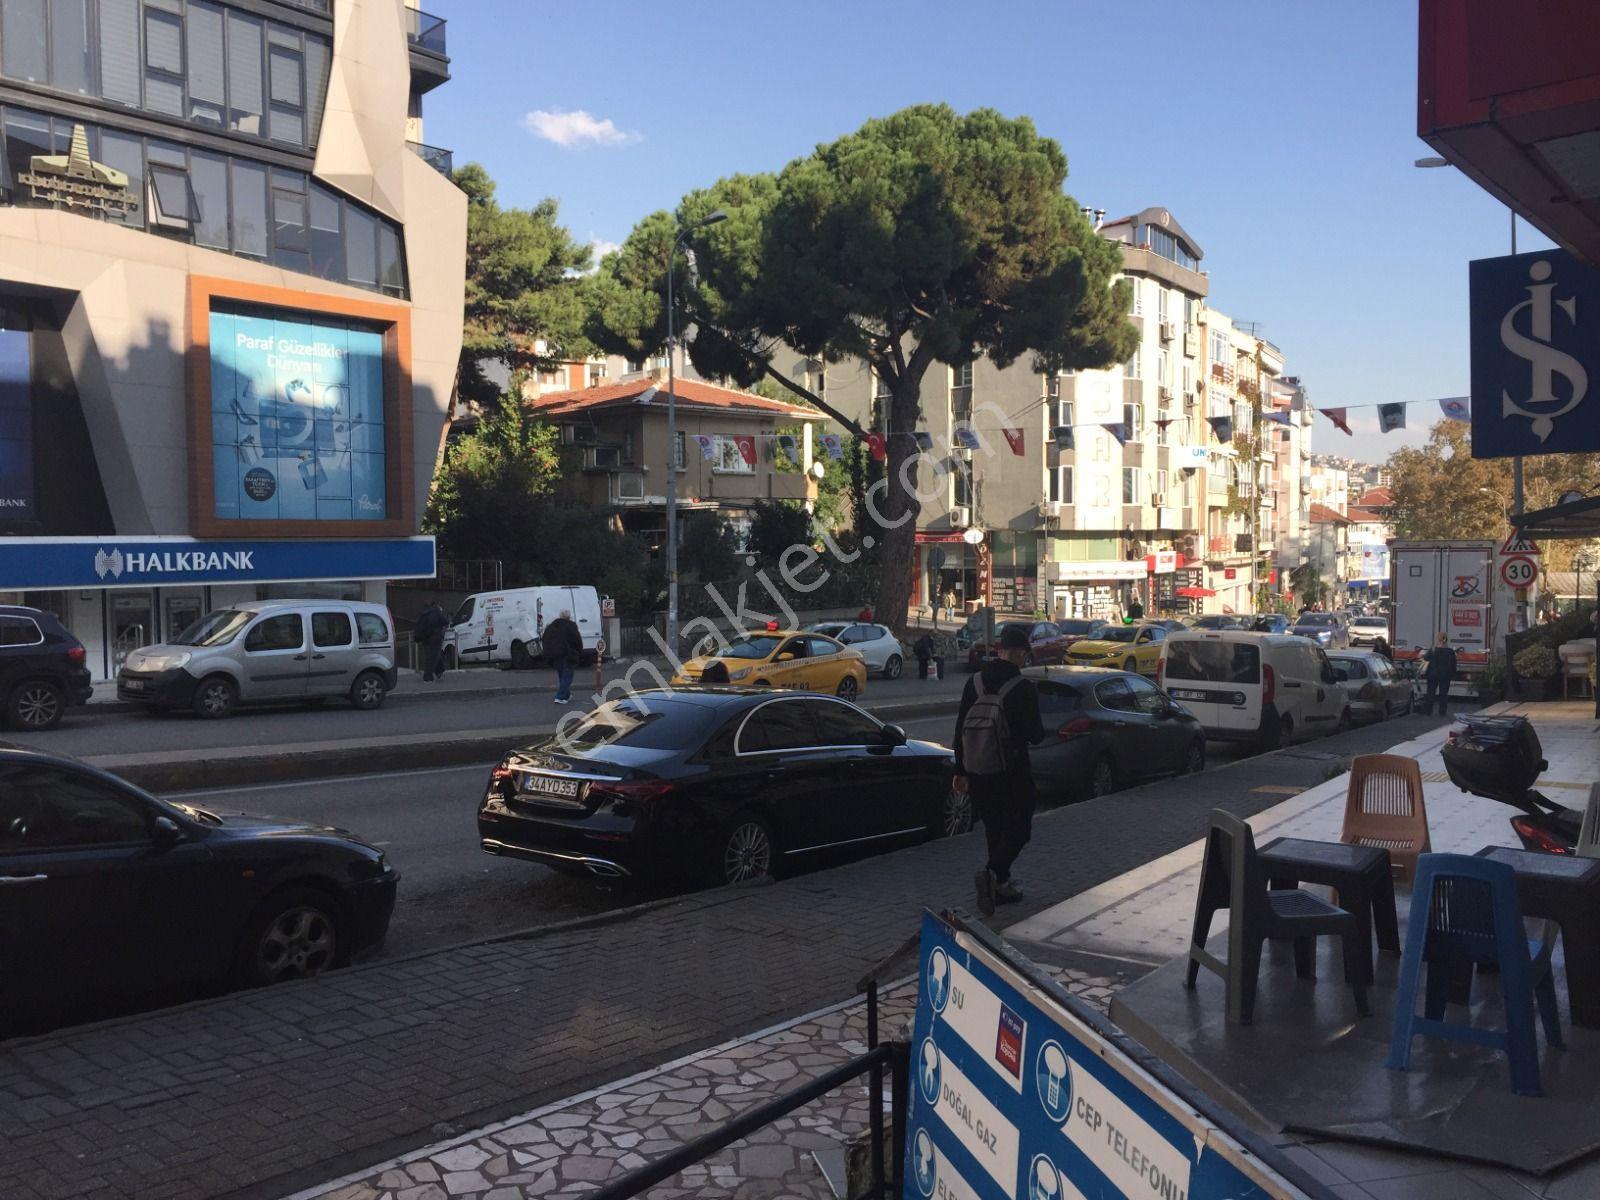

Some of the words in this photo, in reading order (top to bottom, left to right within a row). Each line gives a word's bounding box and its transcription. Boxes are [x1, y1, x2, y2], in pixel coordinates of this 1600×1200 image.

[236, 333, 274, 351] Paraf
[126, 551, 254, 572] HALKBANK
[1508, 564, 1531, 580] 30
[951, 986, 965, 1010] SU
[943, 1083, 974, 1131] DOĞAL
[976, 1119, 998, 1156] GAZ
[1076, 1096, 1102, 1132] CEP
